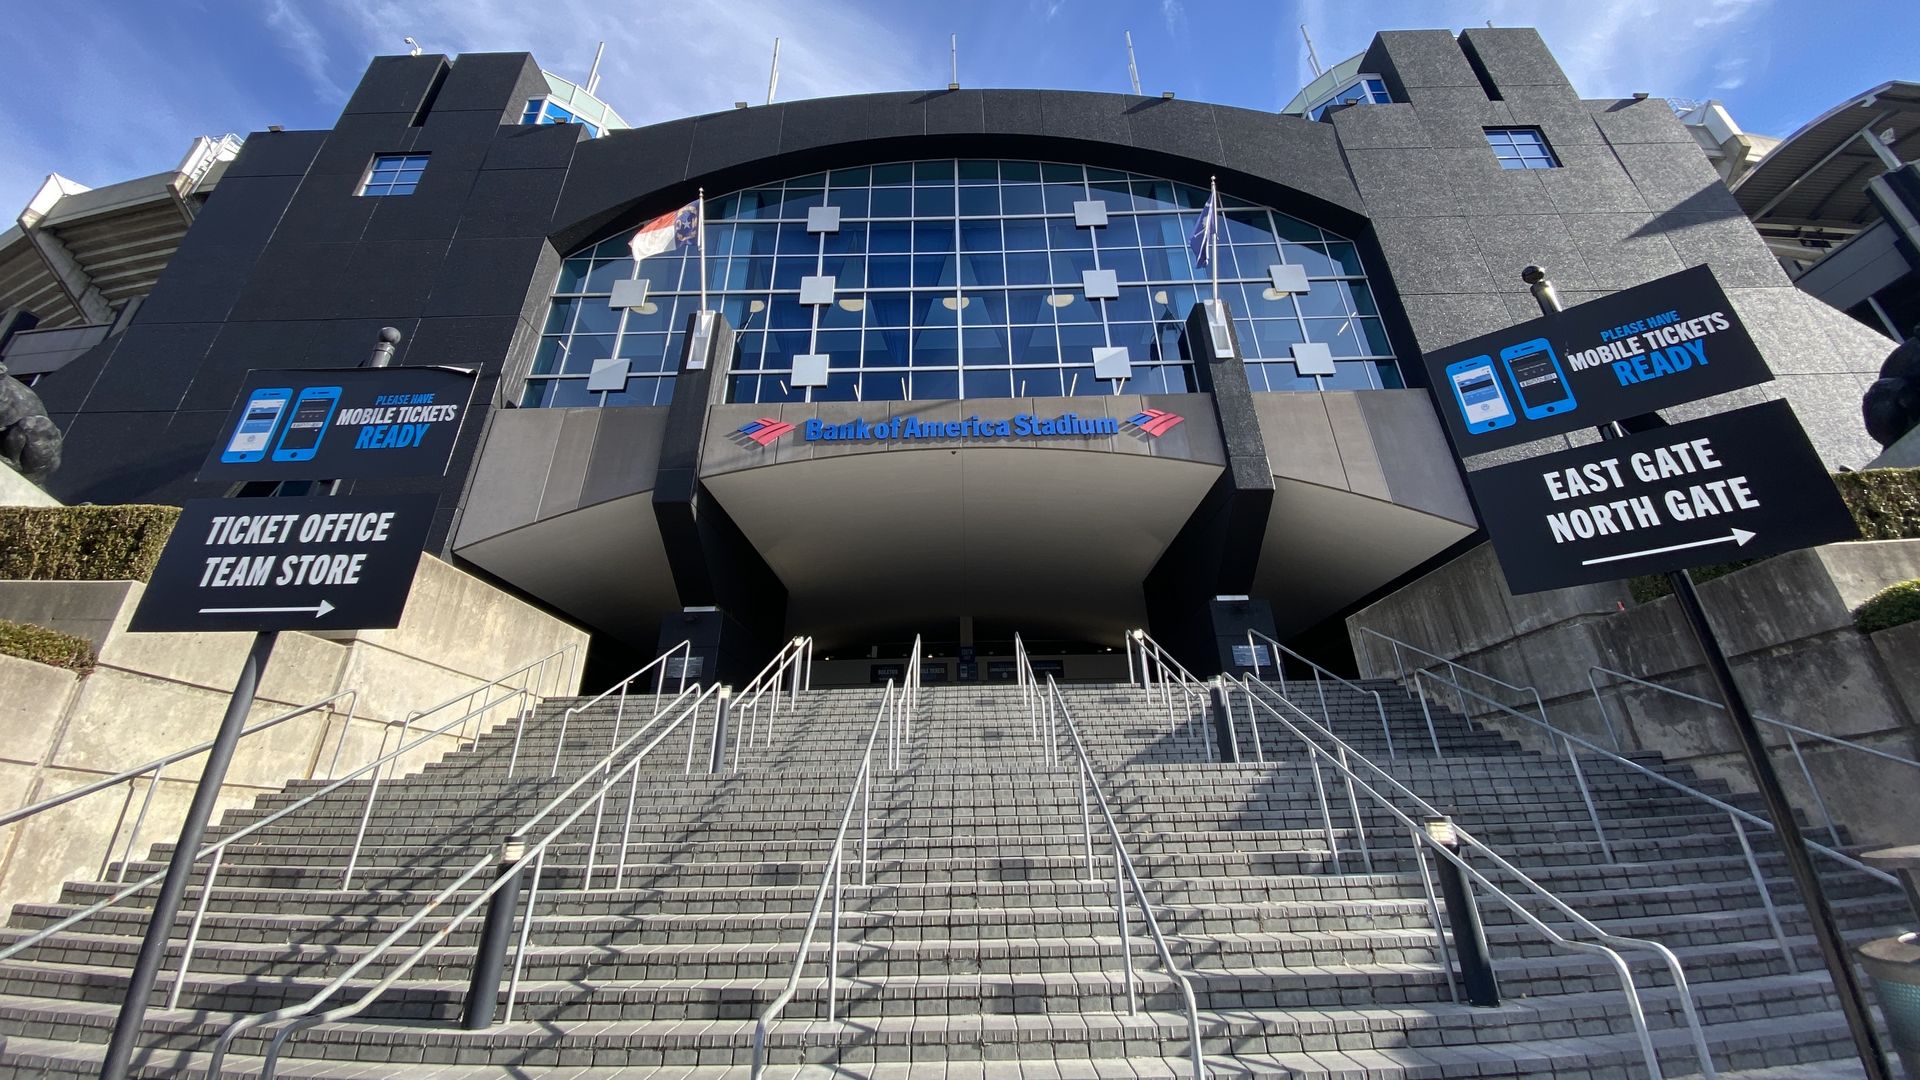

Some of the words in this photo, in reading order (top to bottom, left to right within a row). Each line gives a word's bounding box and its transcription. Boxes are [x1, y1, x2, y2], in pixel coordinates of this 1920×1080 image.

[1567, 336, 1645, 372] MOBILE
[1643, 311, 1730, 352] TICKETS
[1600, 318, 1645, 343] PLEASE
[1646, 310, 1680, 329] HAVE
[1611, 338, 1709, 387] READY
[336, 407, 397, 426] MOBILE
[399, 405, 458, 424] TICKETS
[375, 395, 408, 406] PLEASE
[409, 393, 435, 404] HAVE
[354, 424, 430, 449] READY
[805, 417, 871, 441] Bank
[874, 416, 902, 439] of
[903, 415, 1010, 438] America
[1014, 413, 1119, 436] Stadium
[1543, 458, 1624, 501] EAST
[1630, 437, 1722, 482] GATE
[1546, 495, 1661, 544] NORTH
[1664, 476, 1760, 521] GATE
[205, 514, 299, 545] TICKET
[299, 512, 395, 543] OFFICE
[200, 556, 276, 587] TEAM
[276, 554, 367, 585] STORE
